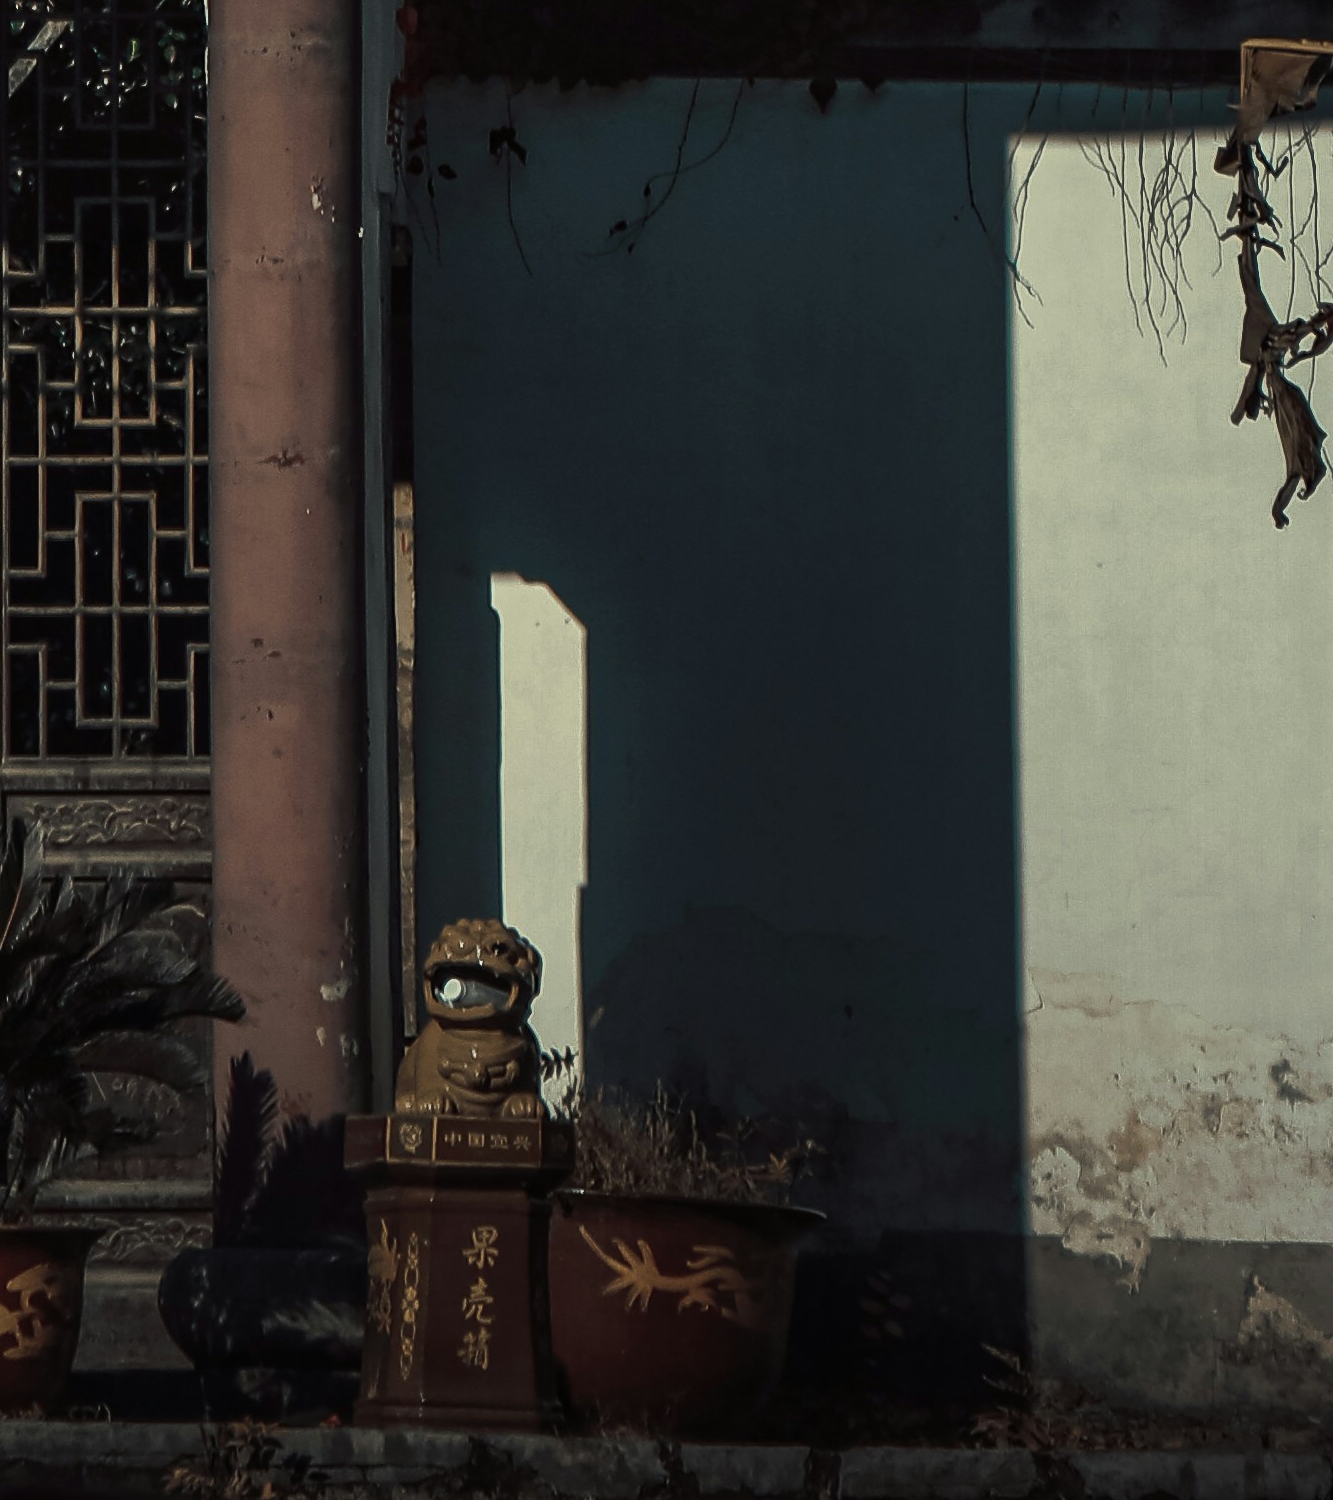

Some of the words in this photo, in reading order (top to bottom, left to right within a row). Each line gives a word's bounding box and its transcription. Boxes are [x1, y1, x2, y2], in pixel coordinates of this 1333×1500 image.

[443, 1130, 533, 1152] 中国宜兴
[456, 1224, 501, 1371] 果壳箱
